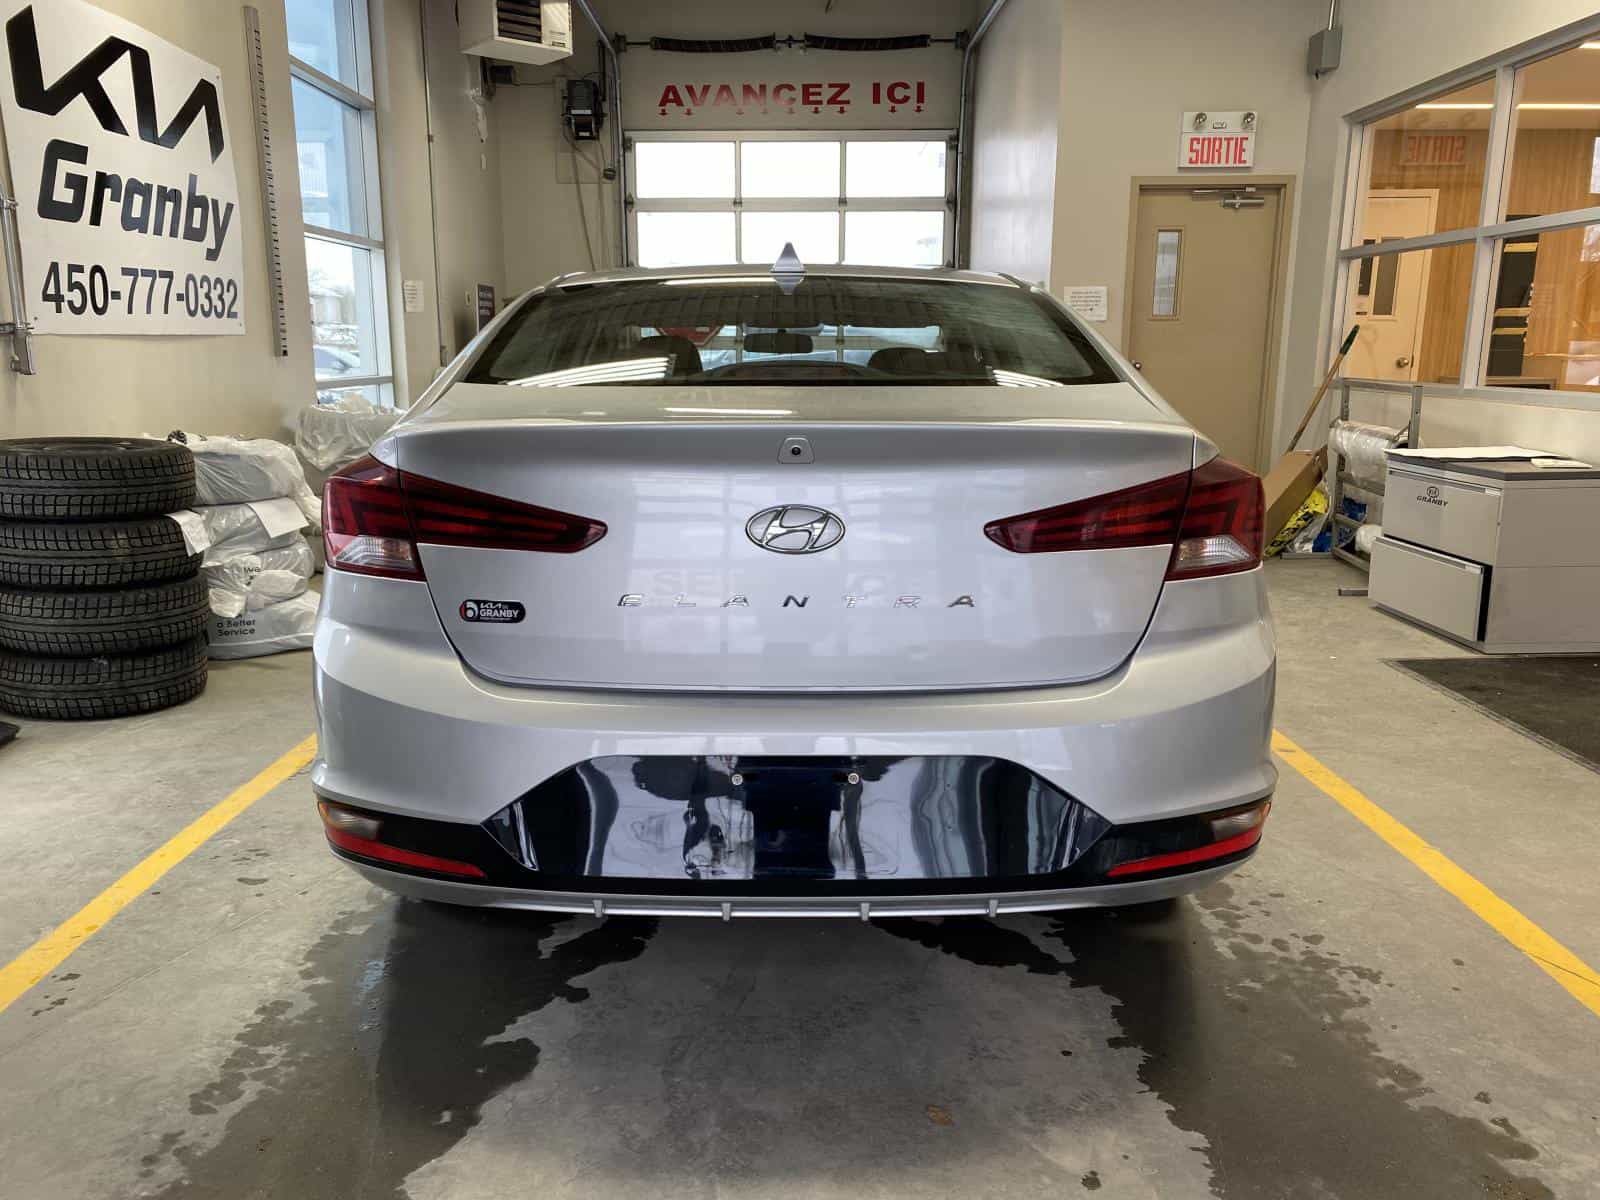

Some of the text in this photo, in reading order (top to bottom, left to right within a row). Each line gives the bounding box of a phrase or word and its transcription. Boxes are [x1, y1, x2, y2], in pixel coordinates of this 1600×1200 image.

[658, 81, 925, 107] AVANCEZ ICI
[1188, 136, 1249, 165] SORTIE
[37, 138, 234, 262] Granby
[41, 261, 238, 319] 450-777-0332
[617, 593, 976, 608] ELANTRA
[480, 608, 519, 618] GRANBY
[217, 628, 256, 637] Service
[226, 619, 256, 629] Better
